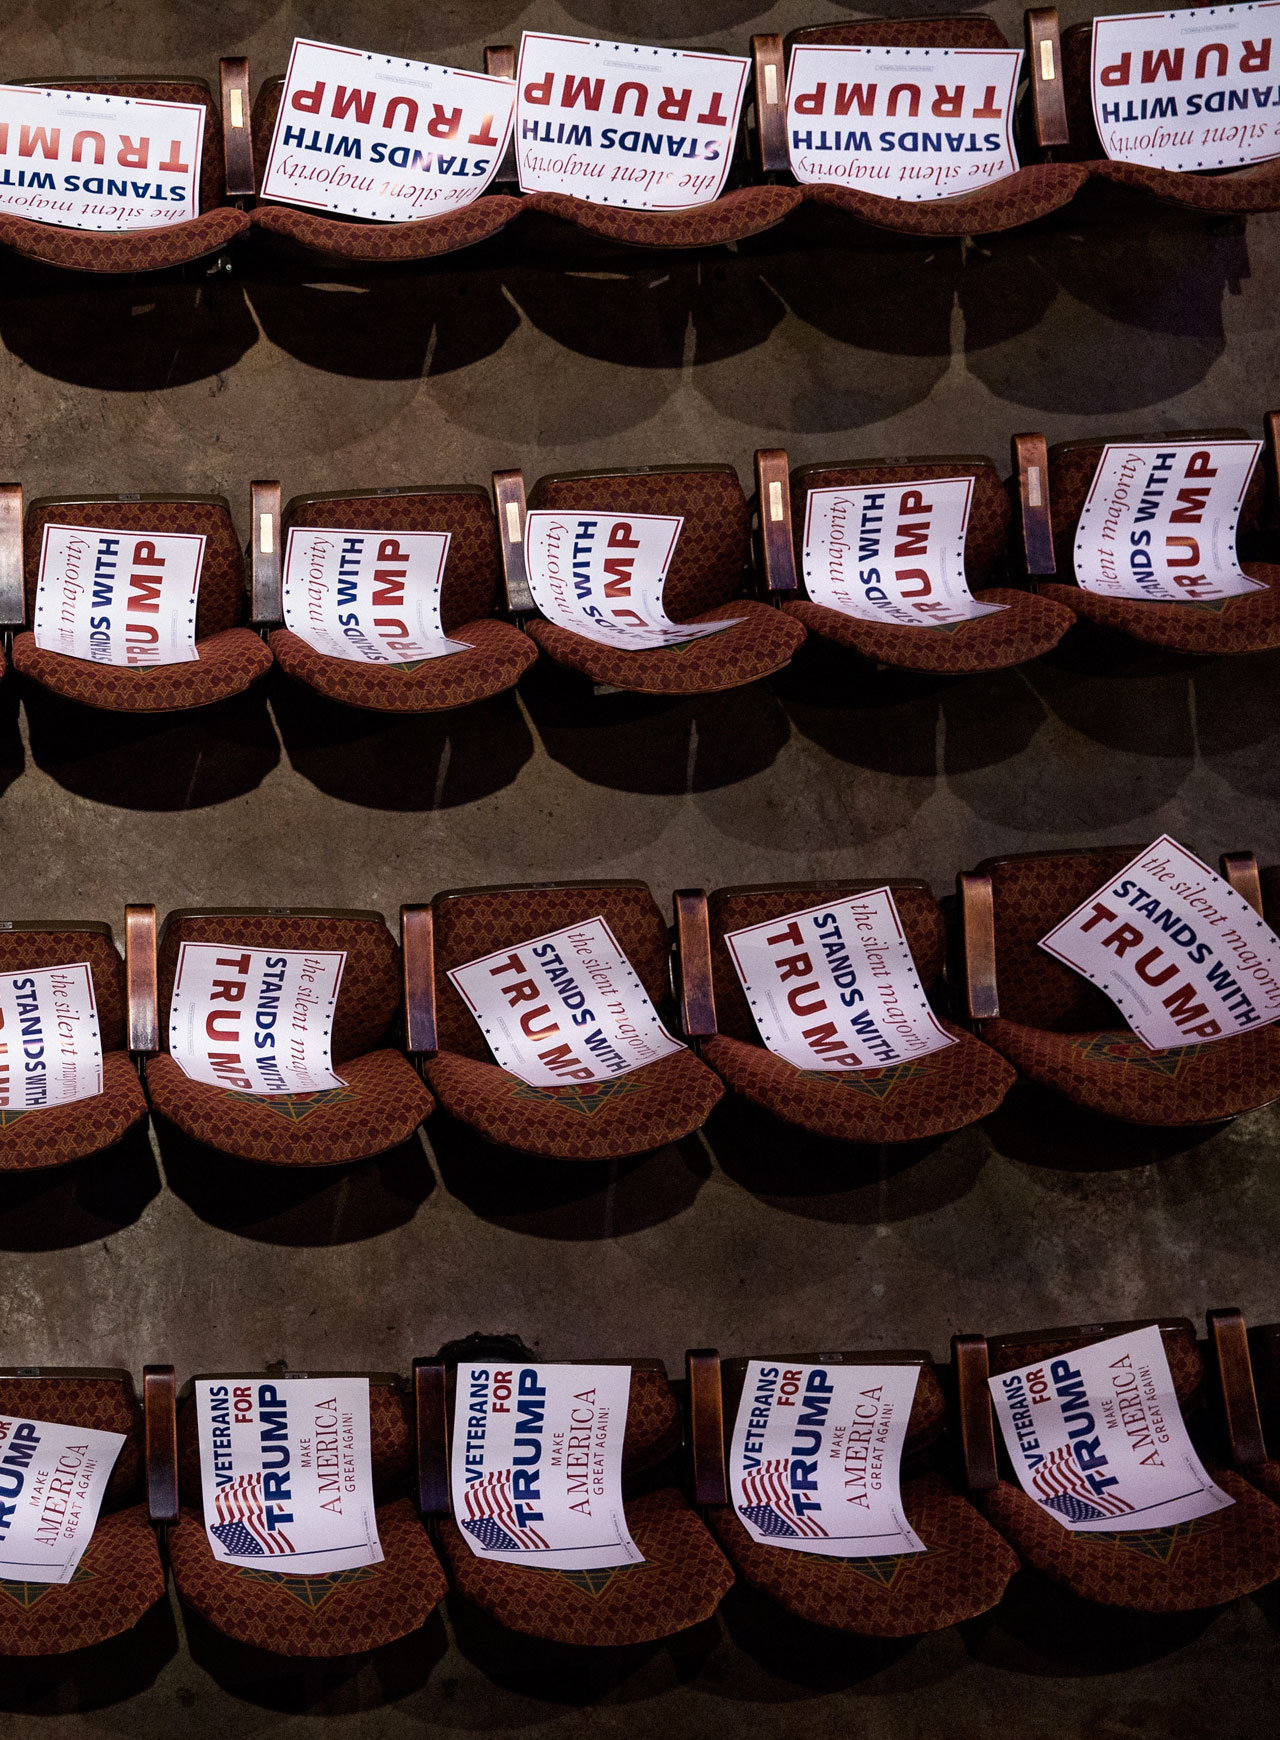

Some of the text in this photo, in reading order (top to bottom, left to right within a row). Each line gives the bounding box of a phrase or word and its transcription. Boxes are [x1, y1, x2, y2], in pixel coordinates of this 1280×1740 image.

[522, 118, 721, 161] STANDS WITH
[523, 72, 727, 127] TRUMP
[1102, 97, 1178, 123] WITH
[276, 155, 375, 192] majority
[282, 125, 490, 177] STANDS WITH
[523, 148, 717, 195] the majority
[793, 130, 1001, 152] STANDS WITH
[798, 156, 962, 185] silent majority
[1109, 123, 1268, 158] silent majority
[81, 204, 145, 221] silent
[858, 493, 885, 562] WITH
[1101, 453, 1146, 540] majority
[1165, 450, 1224, 598] TRUMP
[57, 535, 90, 623] majority
[91, 538, 120, 608] WITH
[300, 536, 334, 622] majority
[337, 538, 364, 606] WITH
[540, 521, 570, 614] majority
[572, 521, 598, 600] WITH
[821, 496, 855, 582] majority
[894, 490, 966, 621] TRUMP
[125, 540, 166, 664] TRUMP
[372, 539, 432, 659] TRUMP
[1141, 857, 1227, 927] the silent
[50, 974, 74, 998] the
[301, 963, 325, 988] the
[532, 943, 595, 1026] STANDS
[567, 932, 618, 997] the silent
[813, 912, 900, 1062] STANDS WITH
[850, 903, 930, 1052] the silent majority
[1079, 901, 1222, 1038] TRUMP
[1112, 880, 1213, 964] STANDS
[1206, 960, 1261, 1027] WITH
[54, 1001, 80, 1056] silent
[254, 962, 290, 1096] STANDS WITH
[292, 990, 319, 1036] silent
[489, 953, 595, 1081] TRUMP
[766, 921, 863, 1068] TRUMP
[25, 1073, 47, 1106] WITH
[465, 1369, 490, 1483] VETERANS
[492, 1370, 513, 1413] FOR
[742, 1367, 779, 1471] VETERANS
[1025, 1367, 1051, 1405] FOR
[1101, 1399, 1119, 1429] MAKE
[1108, 1353, 1165, 1468] AMERICA
[1138, 1365, 1170, 1444] GREAT AGAIN!
[209, 1386, 233, 1487] VETERANS
[258, 1384, 294, 1531] TRUMP
[300, 1437, 311, 1468] MAKE
[314, 1397, 342, 1515] AMERICA
[342, 1412, 356, 1492] GREAT AGAIN!
[512, 1368, 546, 1528] TRUMP
[551, 1432, 564, 1466] MAKE
[593, 1407, 610, 1495] GREAT AGAIN!
[789, 1369, 834, 1516] TRUMP
[829, 1425, 846, 1458] MAKE
[844, 1385, 883, 1510] AMERICA
[870, 1403, 895, 1490] GREAT AGAIN!
[1050, 1359, 1119, 1497] TRUMP
[29, 1470, 49, 1507] MAKE
[33, 1443, 89, 1547] AMERICA
[63, 1501, 83, 1539] GREAT
